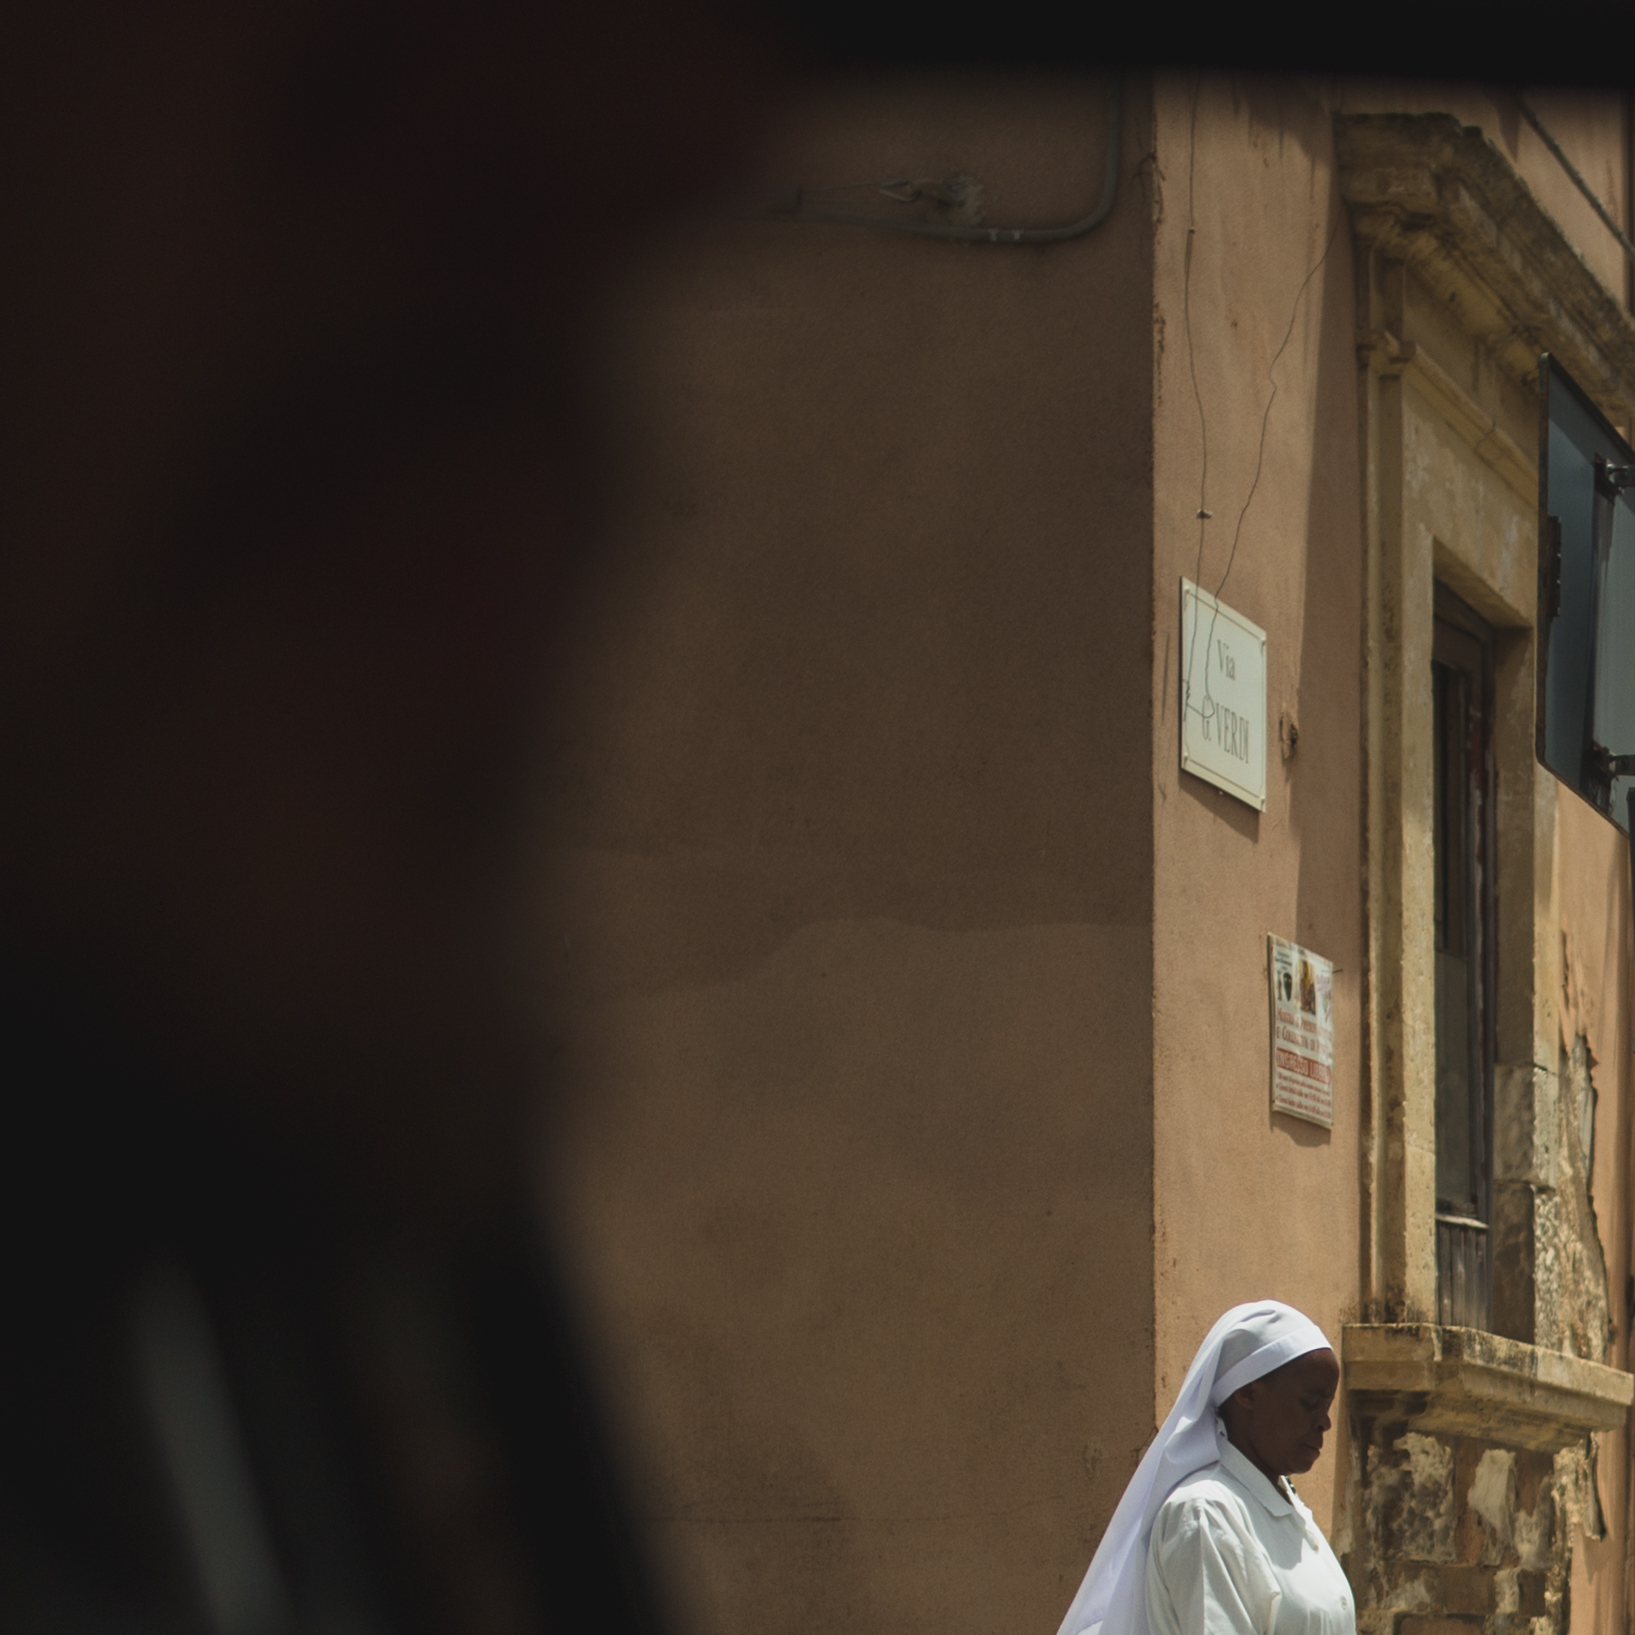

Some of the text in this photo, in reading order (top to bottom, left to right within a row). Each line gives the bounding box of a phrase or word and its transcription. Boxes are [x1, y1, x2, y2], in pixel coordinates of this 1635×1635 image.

[1217, 639, 1235, 681] Via
[1202, 694, 1249, 764] G. VERDI
